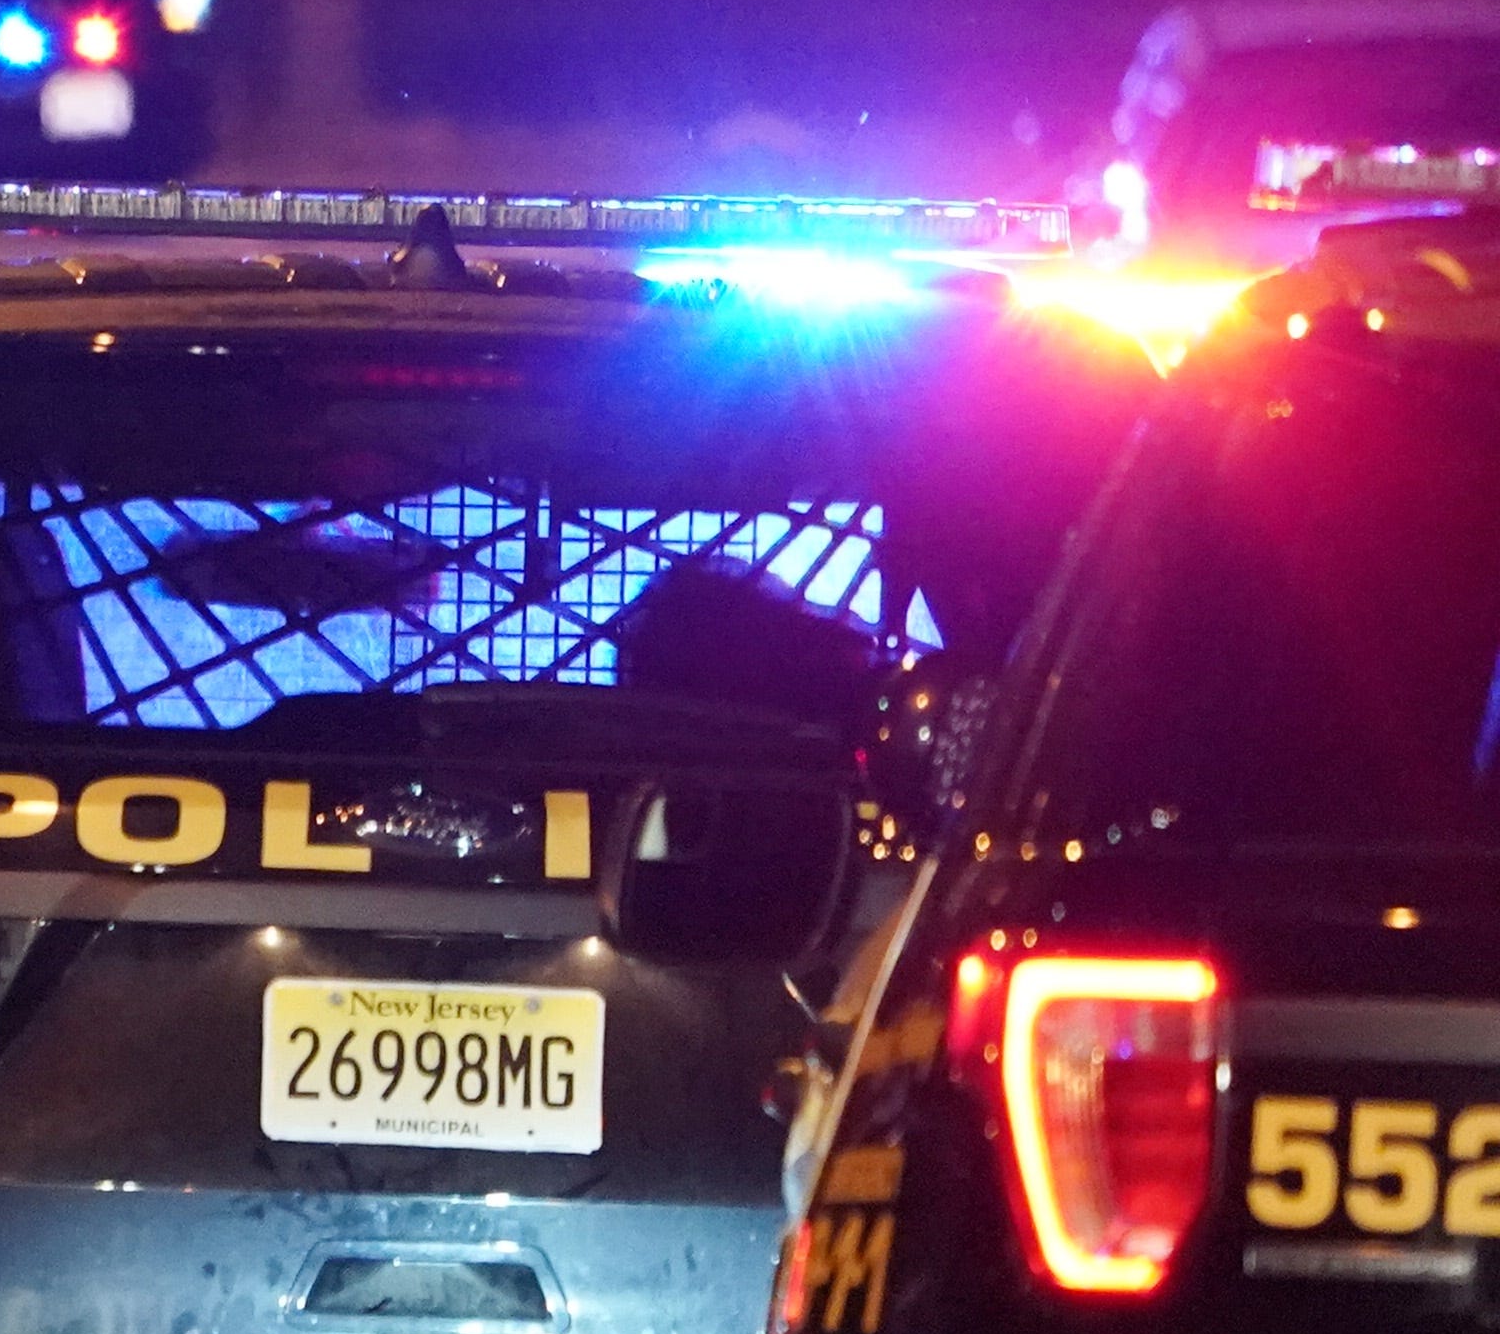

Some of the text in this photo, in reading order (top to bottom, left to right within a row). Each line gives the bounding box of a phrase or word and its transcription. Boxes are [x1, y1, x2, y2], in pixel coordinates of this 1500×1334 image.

[349, 990, 516, 1027] New Jersey
[287, 1026, 575, 1111] 26998MG
[374, 1117, 486, 1139] MUNICIPAL
[1246, 1095, 1500, 1239] 552
